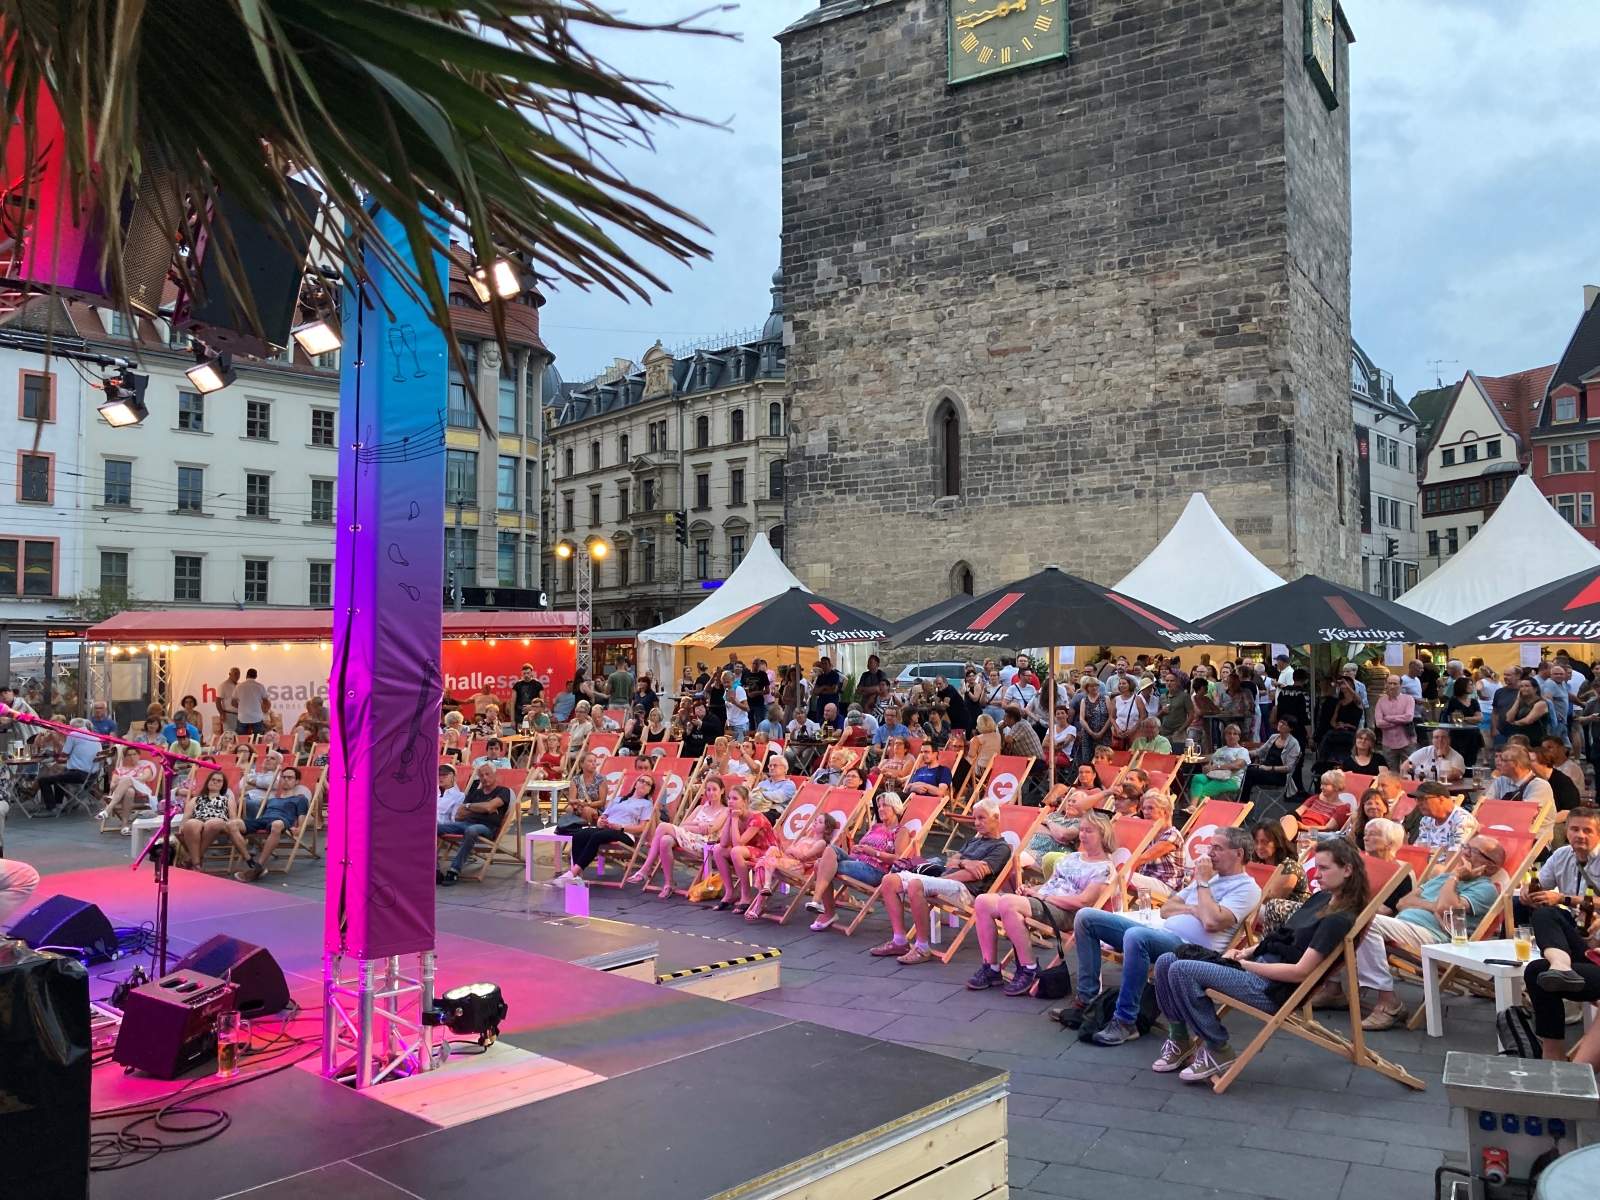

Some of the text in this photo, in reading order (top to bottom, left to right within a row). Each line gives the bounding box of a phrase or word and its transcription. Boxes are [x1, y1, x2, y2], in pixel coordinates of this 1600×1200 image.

[810, 629, 886, 643] Köstritzer
[925, 629, 1009, 643] Köstritzer
[1318, 627, 1405, 642] Köstritzer
[444, 672, 550, 690] hallesae
